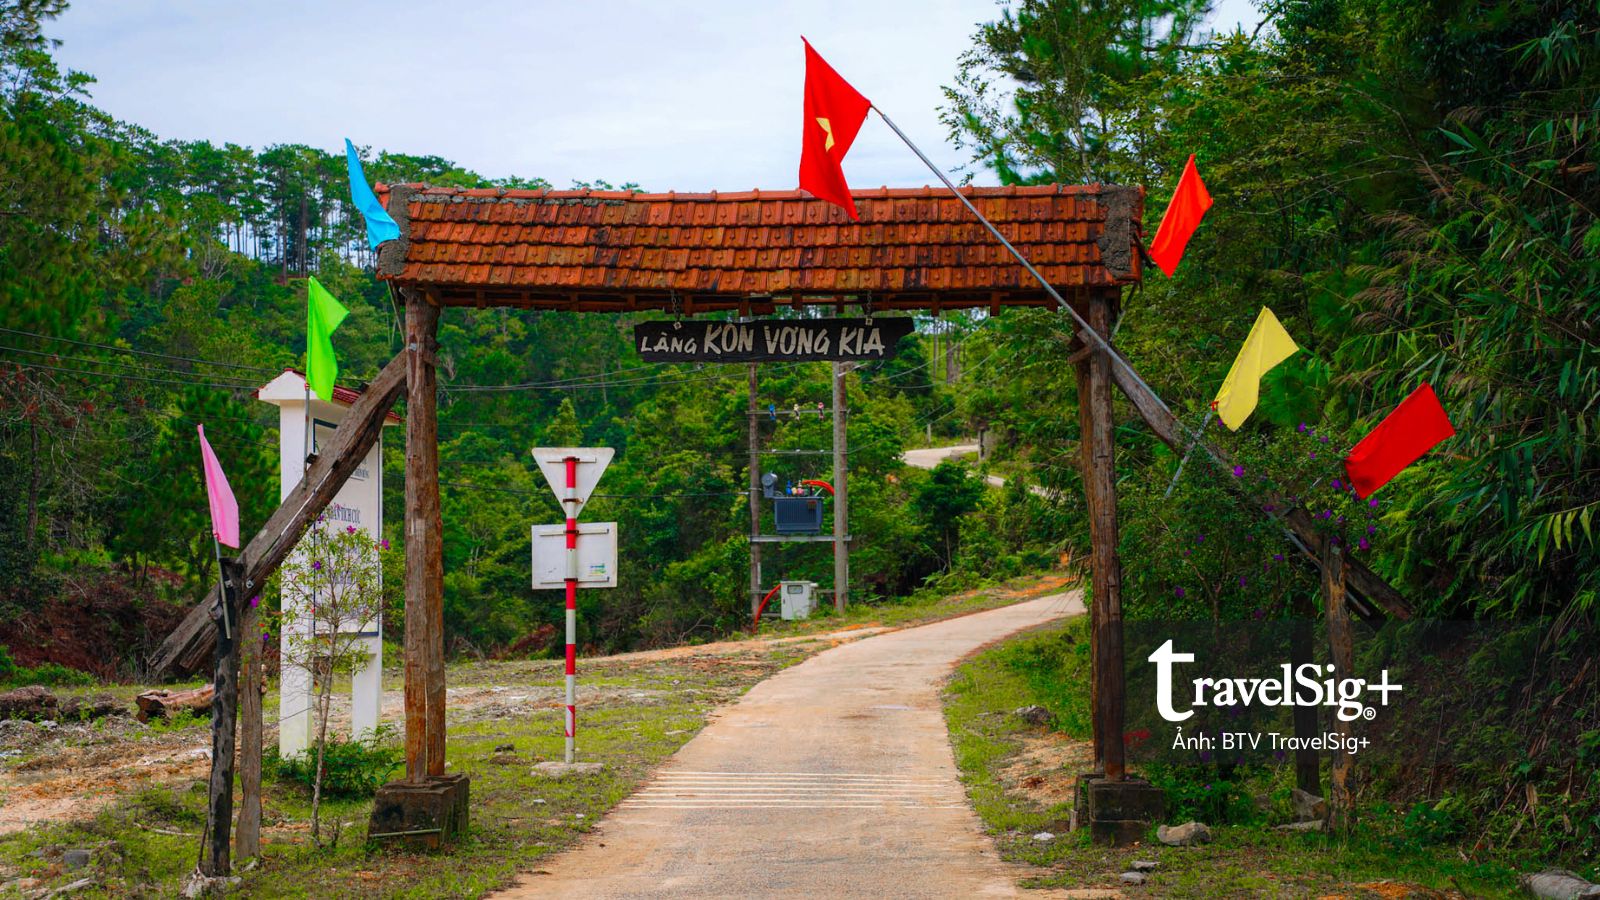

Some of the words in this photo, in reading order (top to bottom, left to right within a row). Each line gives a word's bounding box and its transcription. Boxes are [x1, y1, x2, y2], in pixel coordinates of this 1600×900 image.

[640, 331, 697, 355] LÀNG
[703, 324, 754, 355] KON
[764, 326, 830, 355] VƠNG
[838, 327, 886, 356] KIA
